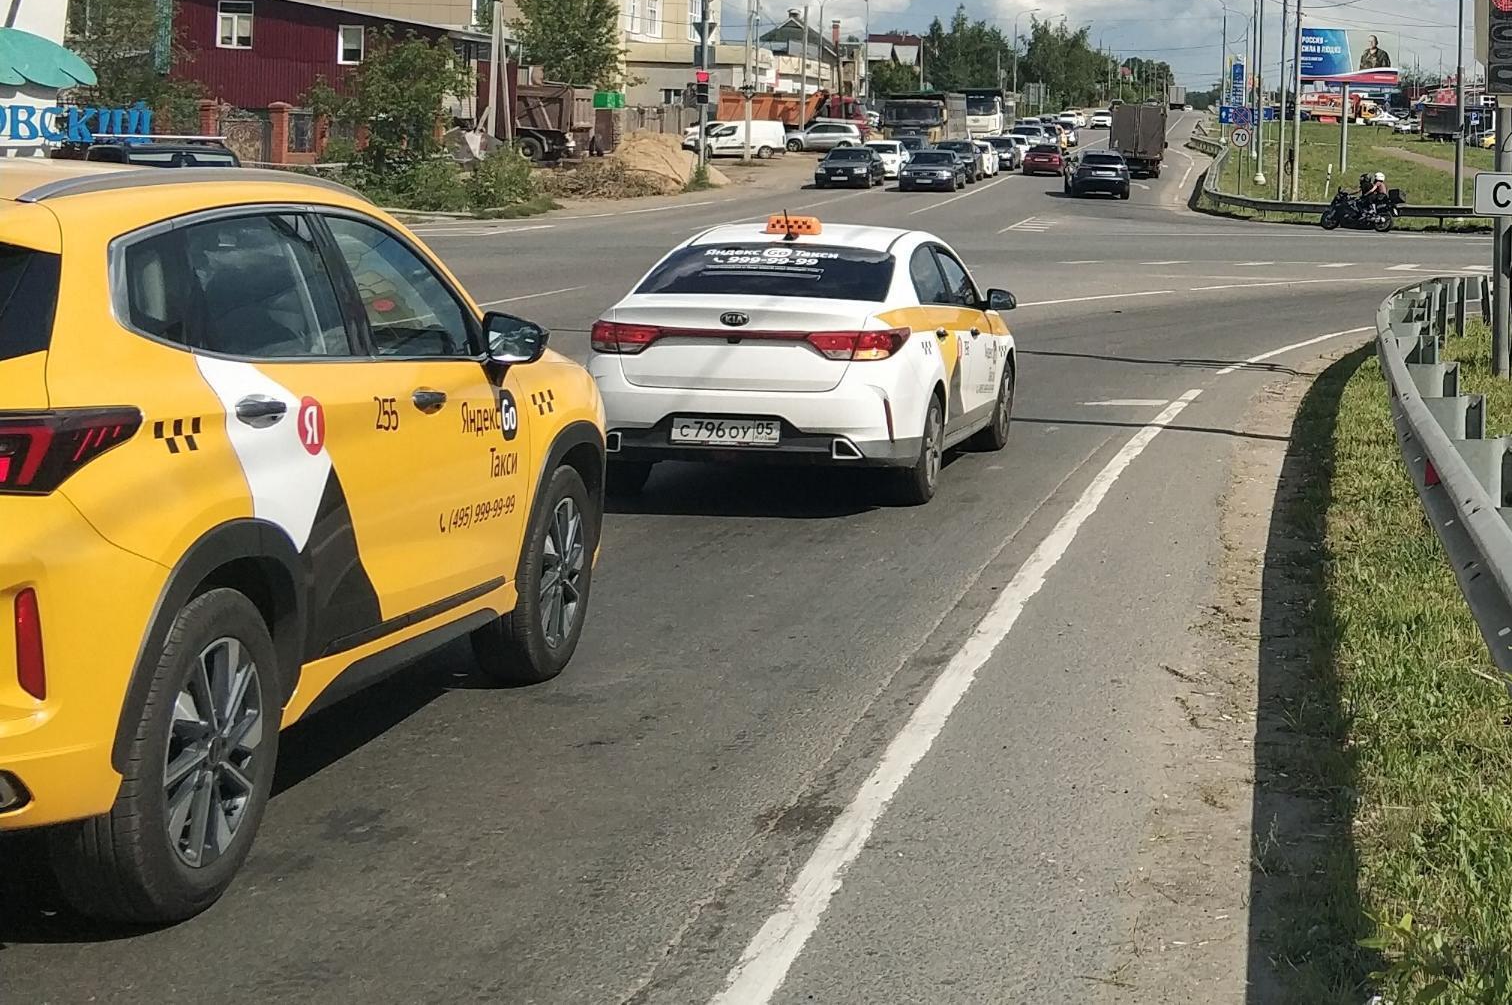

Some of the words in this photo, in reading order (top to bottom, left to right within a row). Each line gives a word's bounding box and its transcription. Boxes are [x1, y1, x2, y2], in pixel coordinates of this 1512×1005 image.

[0, 100, 154, 144] ВСКИЙ
[1235, 132, 1247, 142] 70
[704, 248, 762, 256] Яндекс
[795, 250, 839, 259] Такси
[727, 256, 819, 265] 999-99-99
[304, 405, 319, 445] Я
[373, 396, 399, 431] 255
[461, 402, 501, 436] Яндекс
[502, 399, 517, 432] Go
[756, 422, 775, 436] 05
[490, 447, 518, 478] Такси
[448, 505, 473, 534] (495)
[473, 494, 516, 524] 999-99-99
